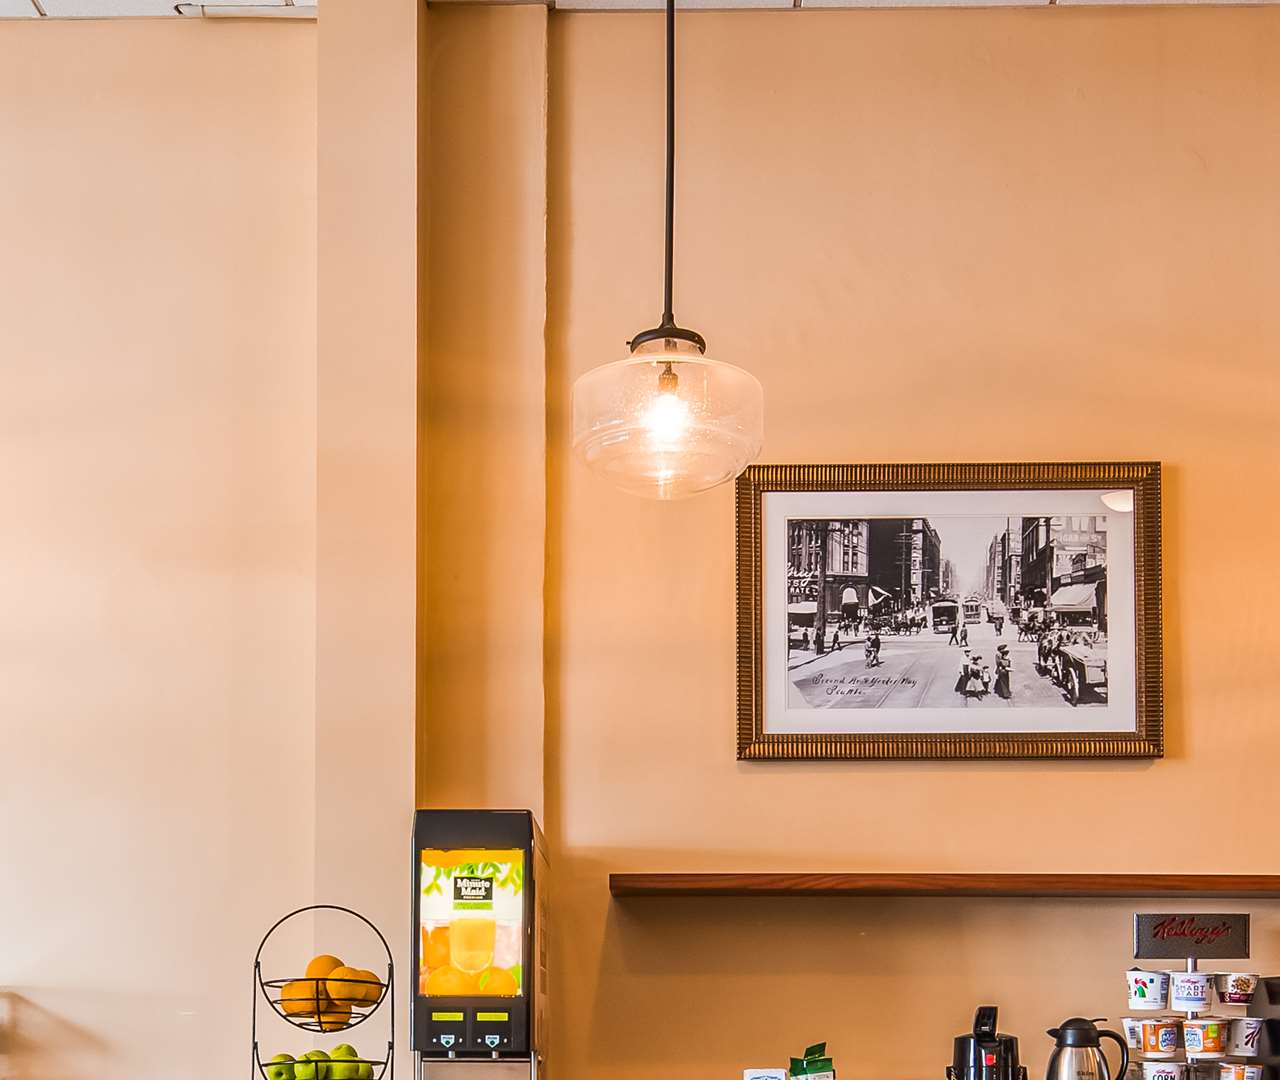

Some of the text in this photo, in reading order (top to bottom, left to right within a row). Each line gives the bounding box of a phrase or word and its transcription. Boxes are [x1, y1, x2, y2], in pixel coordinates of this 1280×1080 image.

[456, 878, 491, 888] Minute
[461, 887, 487, 896] Maid
[1152, 916, 1232, 945] Kellogg's
